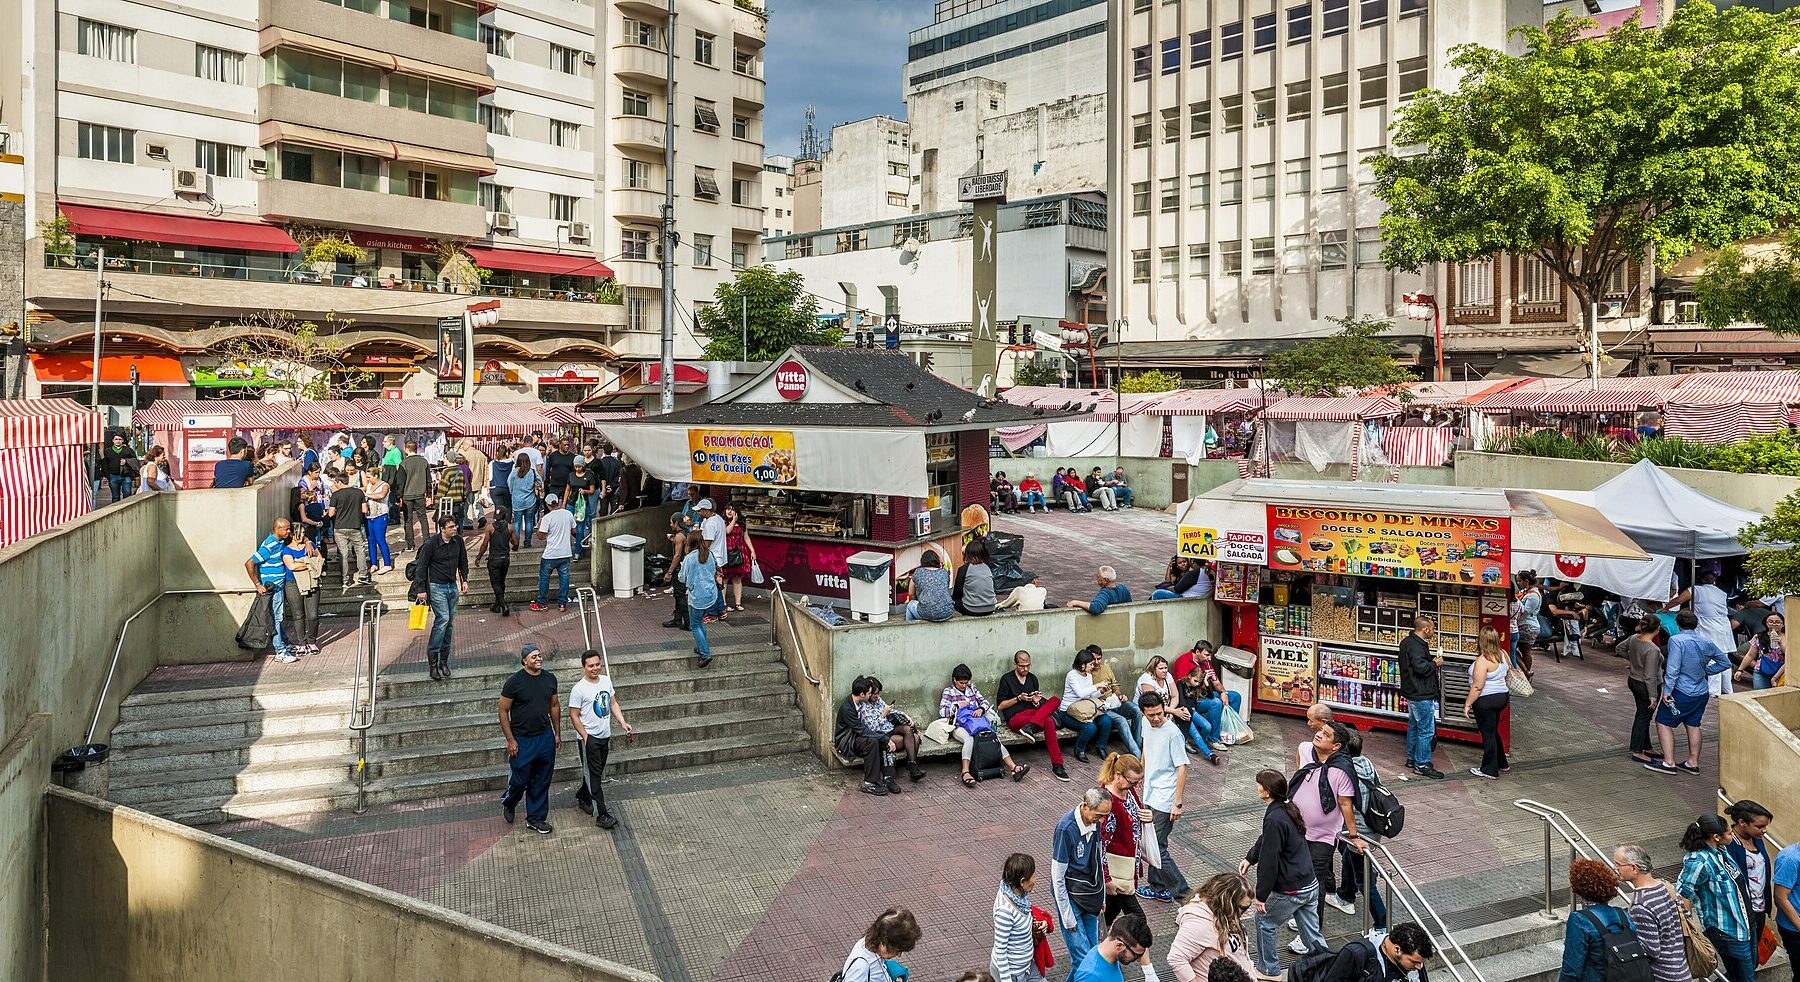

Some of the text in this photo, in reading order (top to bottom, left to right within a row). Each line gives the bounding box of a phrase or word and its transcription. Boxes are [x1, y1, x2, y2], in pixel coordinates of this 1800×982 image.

[975, 183, 1001, 193] LIBERDADE
[366, 240, 412, 250] asian kitchen
[778, 371, 805, 382] Vitta
[1228, 371, 1249, 379] Kim
[778, 382, 805, 391] Panne
[703, 434, 774, 450] PROMOÇÃO!
[694, 453, 705, 462] 10
[709, 453, 728, 463] Mini
[710, 463, 752, 475] de Queijo
[754, 469, 775, 480] 1,00
[1276, 507, 1500, 532] BISCOITO DE MINAS
[1182, 531, 1201, 540] TEMOS
[1321, 524, 1452, 540] DOCES & SALGADOS
[1463, 531, 1505, 540] Salgadinhos
[1227, 533, 1263, 543] TAPIOCA
[1230, 543, 1255, 551] DOCE
[1226, 549, 1263, 561] SALGADA
[1366, 555, 1402, 564] Bebidas
[815, 574, 848, 589] Vitta
[1264, 638, 1312, 649] PROMOÇÃO
[1267, 648, 1307, 662] MEL
[1277, 660, 1308, 668] ABELHAS
